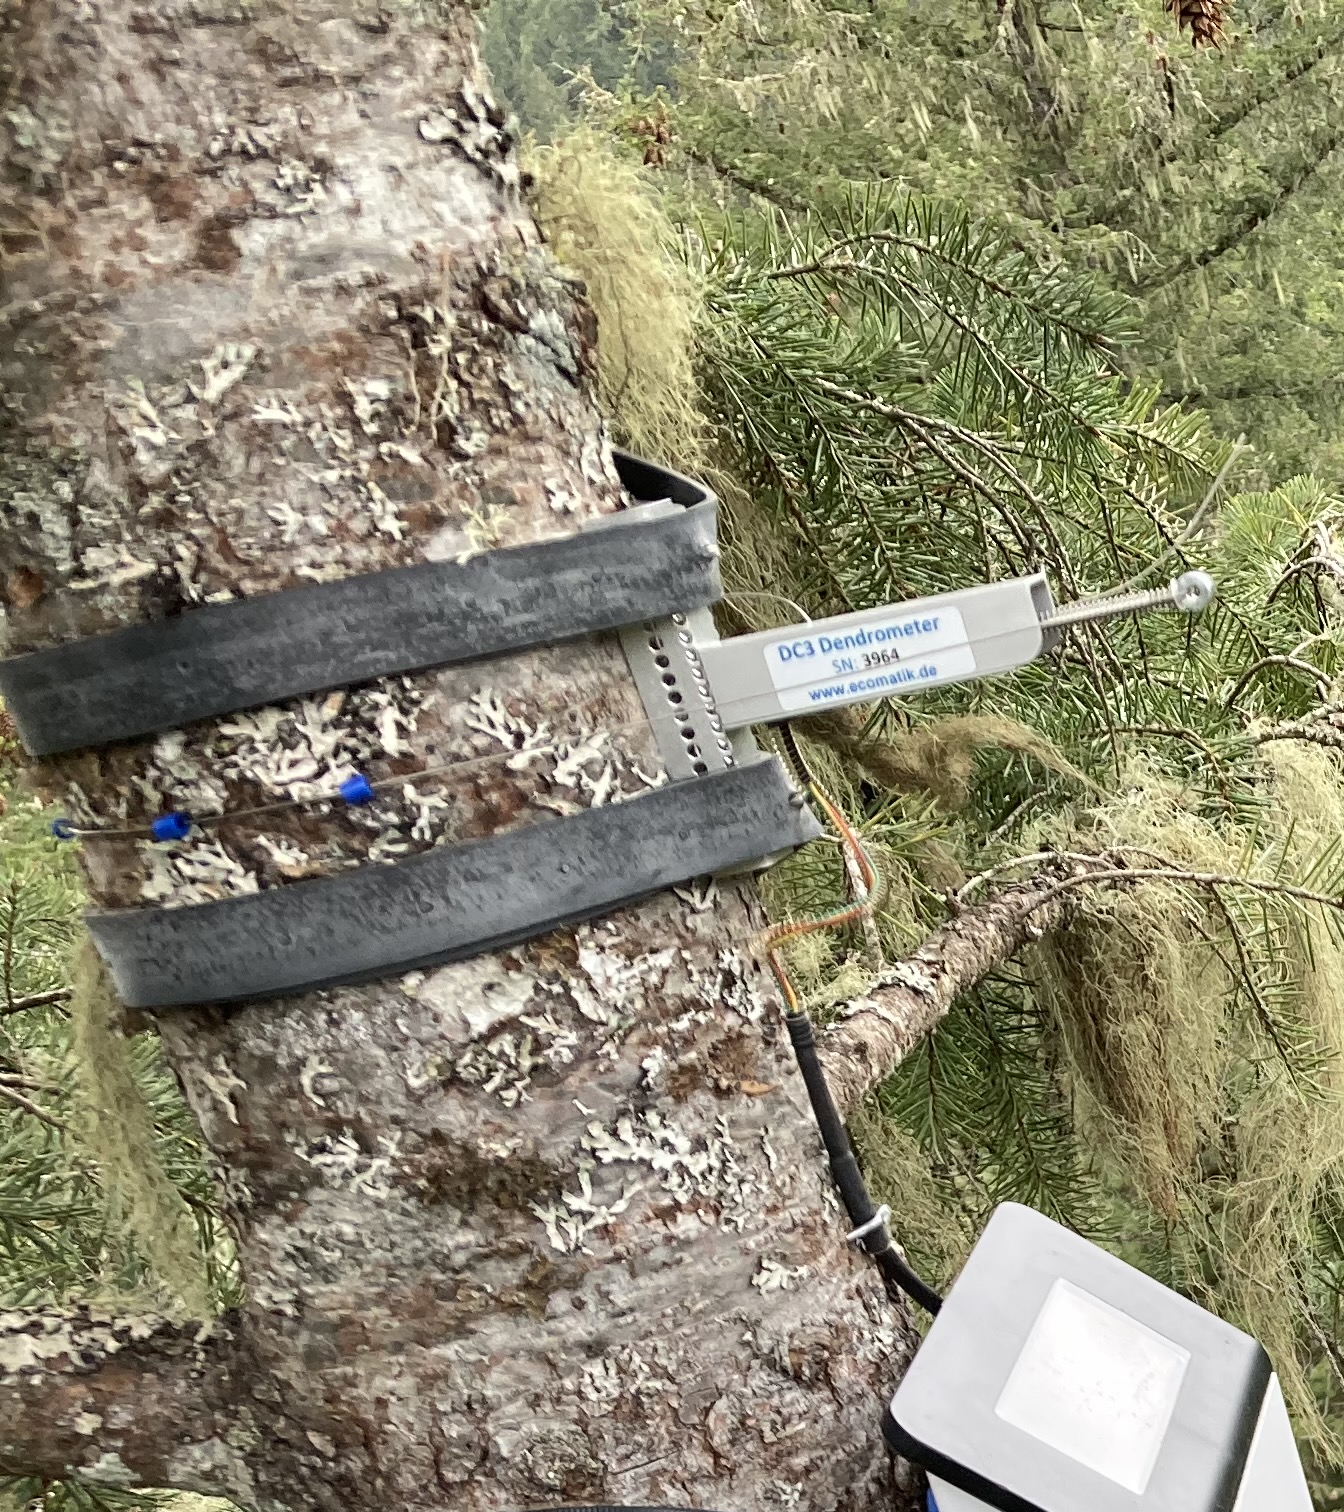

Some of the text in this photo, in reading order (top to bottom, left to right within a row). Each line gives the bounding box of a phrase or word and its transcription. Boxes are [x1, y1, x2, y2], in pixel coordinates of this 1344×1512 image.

[777, 616, 940, 662] DC3 Dendrometer
[832, 648, 900, 674] SN: 3964
[808, 664, 938, 701] www.ecomatik.de
